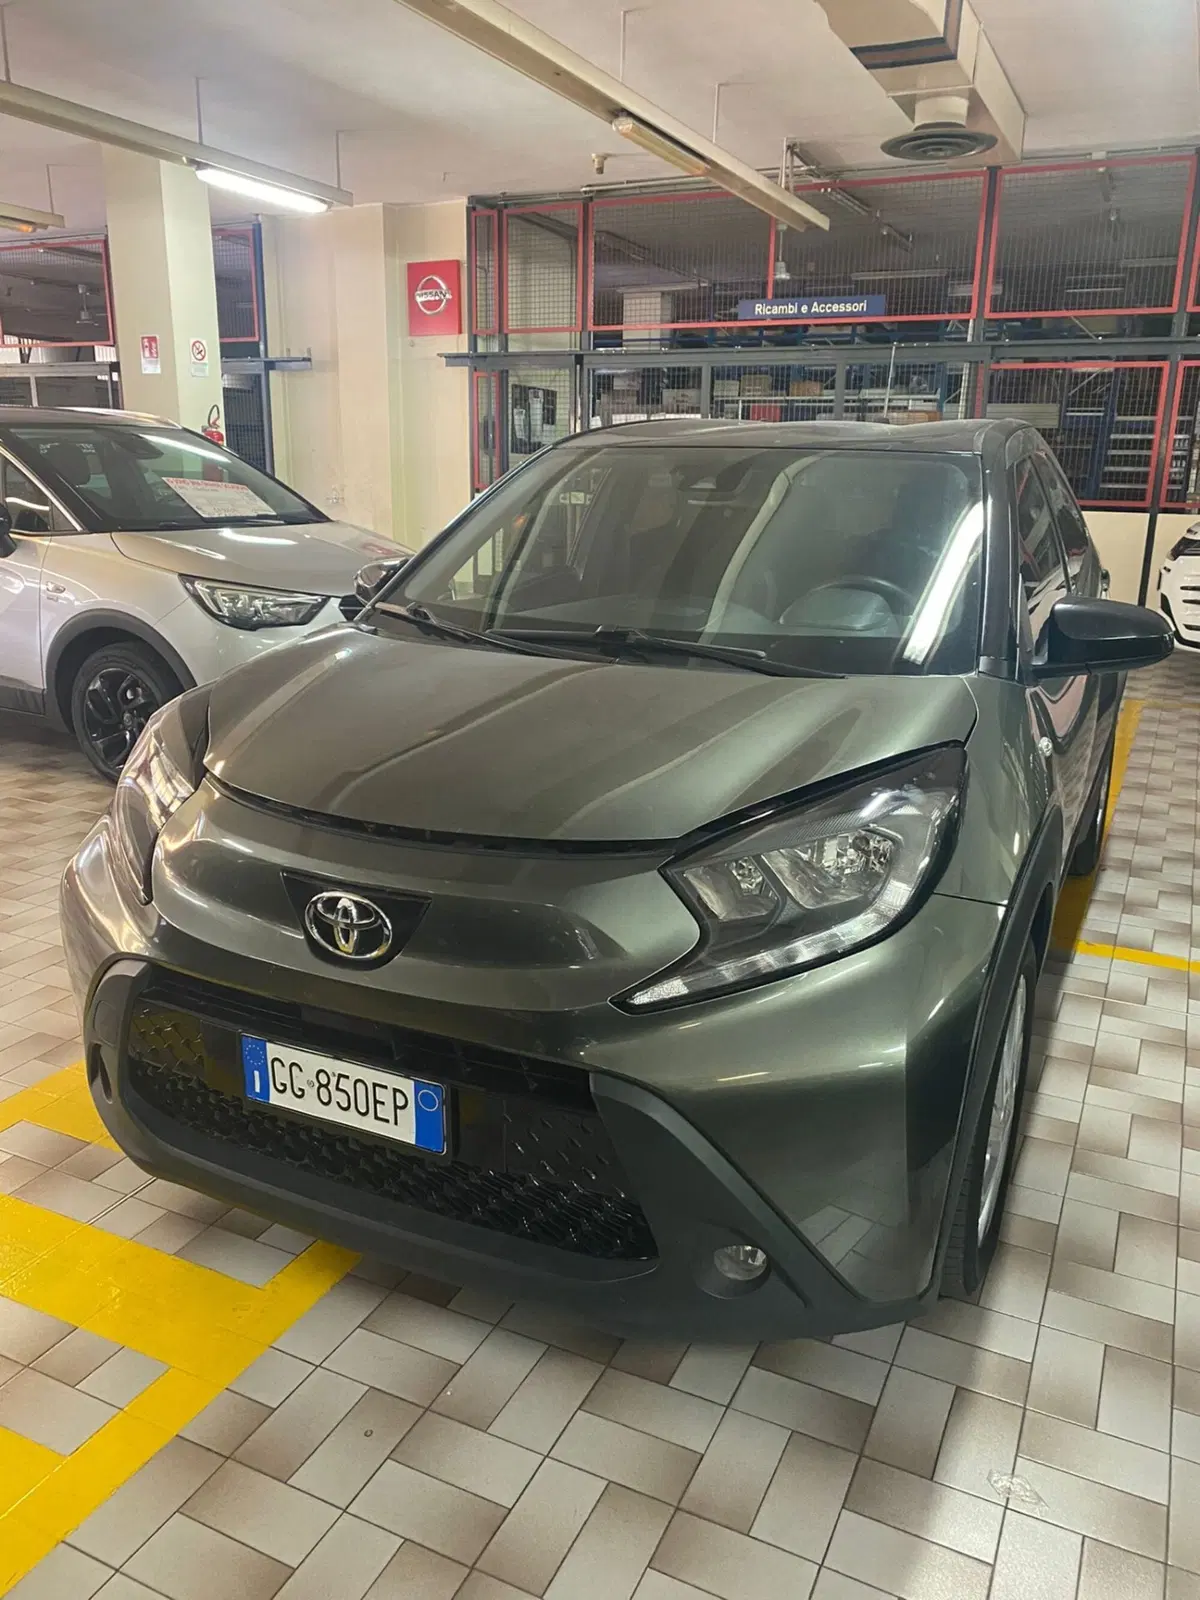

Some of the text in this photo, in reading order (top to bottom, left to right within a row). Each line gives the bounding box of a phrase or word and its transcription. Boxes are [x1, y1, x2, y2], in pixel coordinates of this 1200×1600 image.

[416, 290, 448, 300] NISSAN
[754, 300, 867, 315] Ricambi e Accessori
